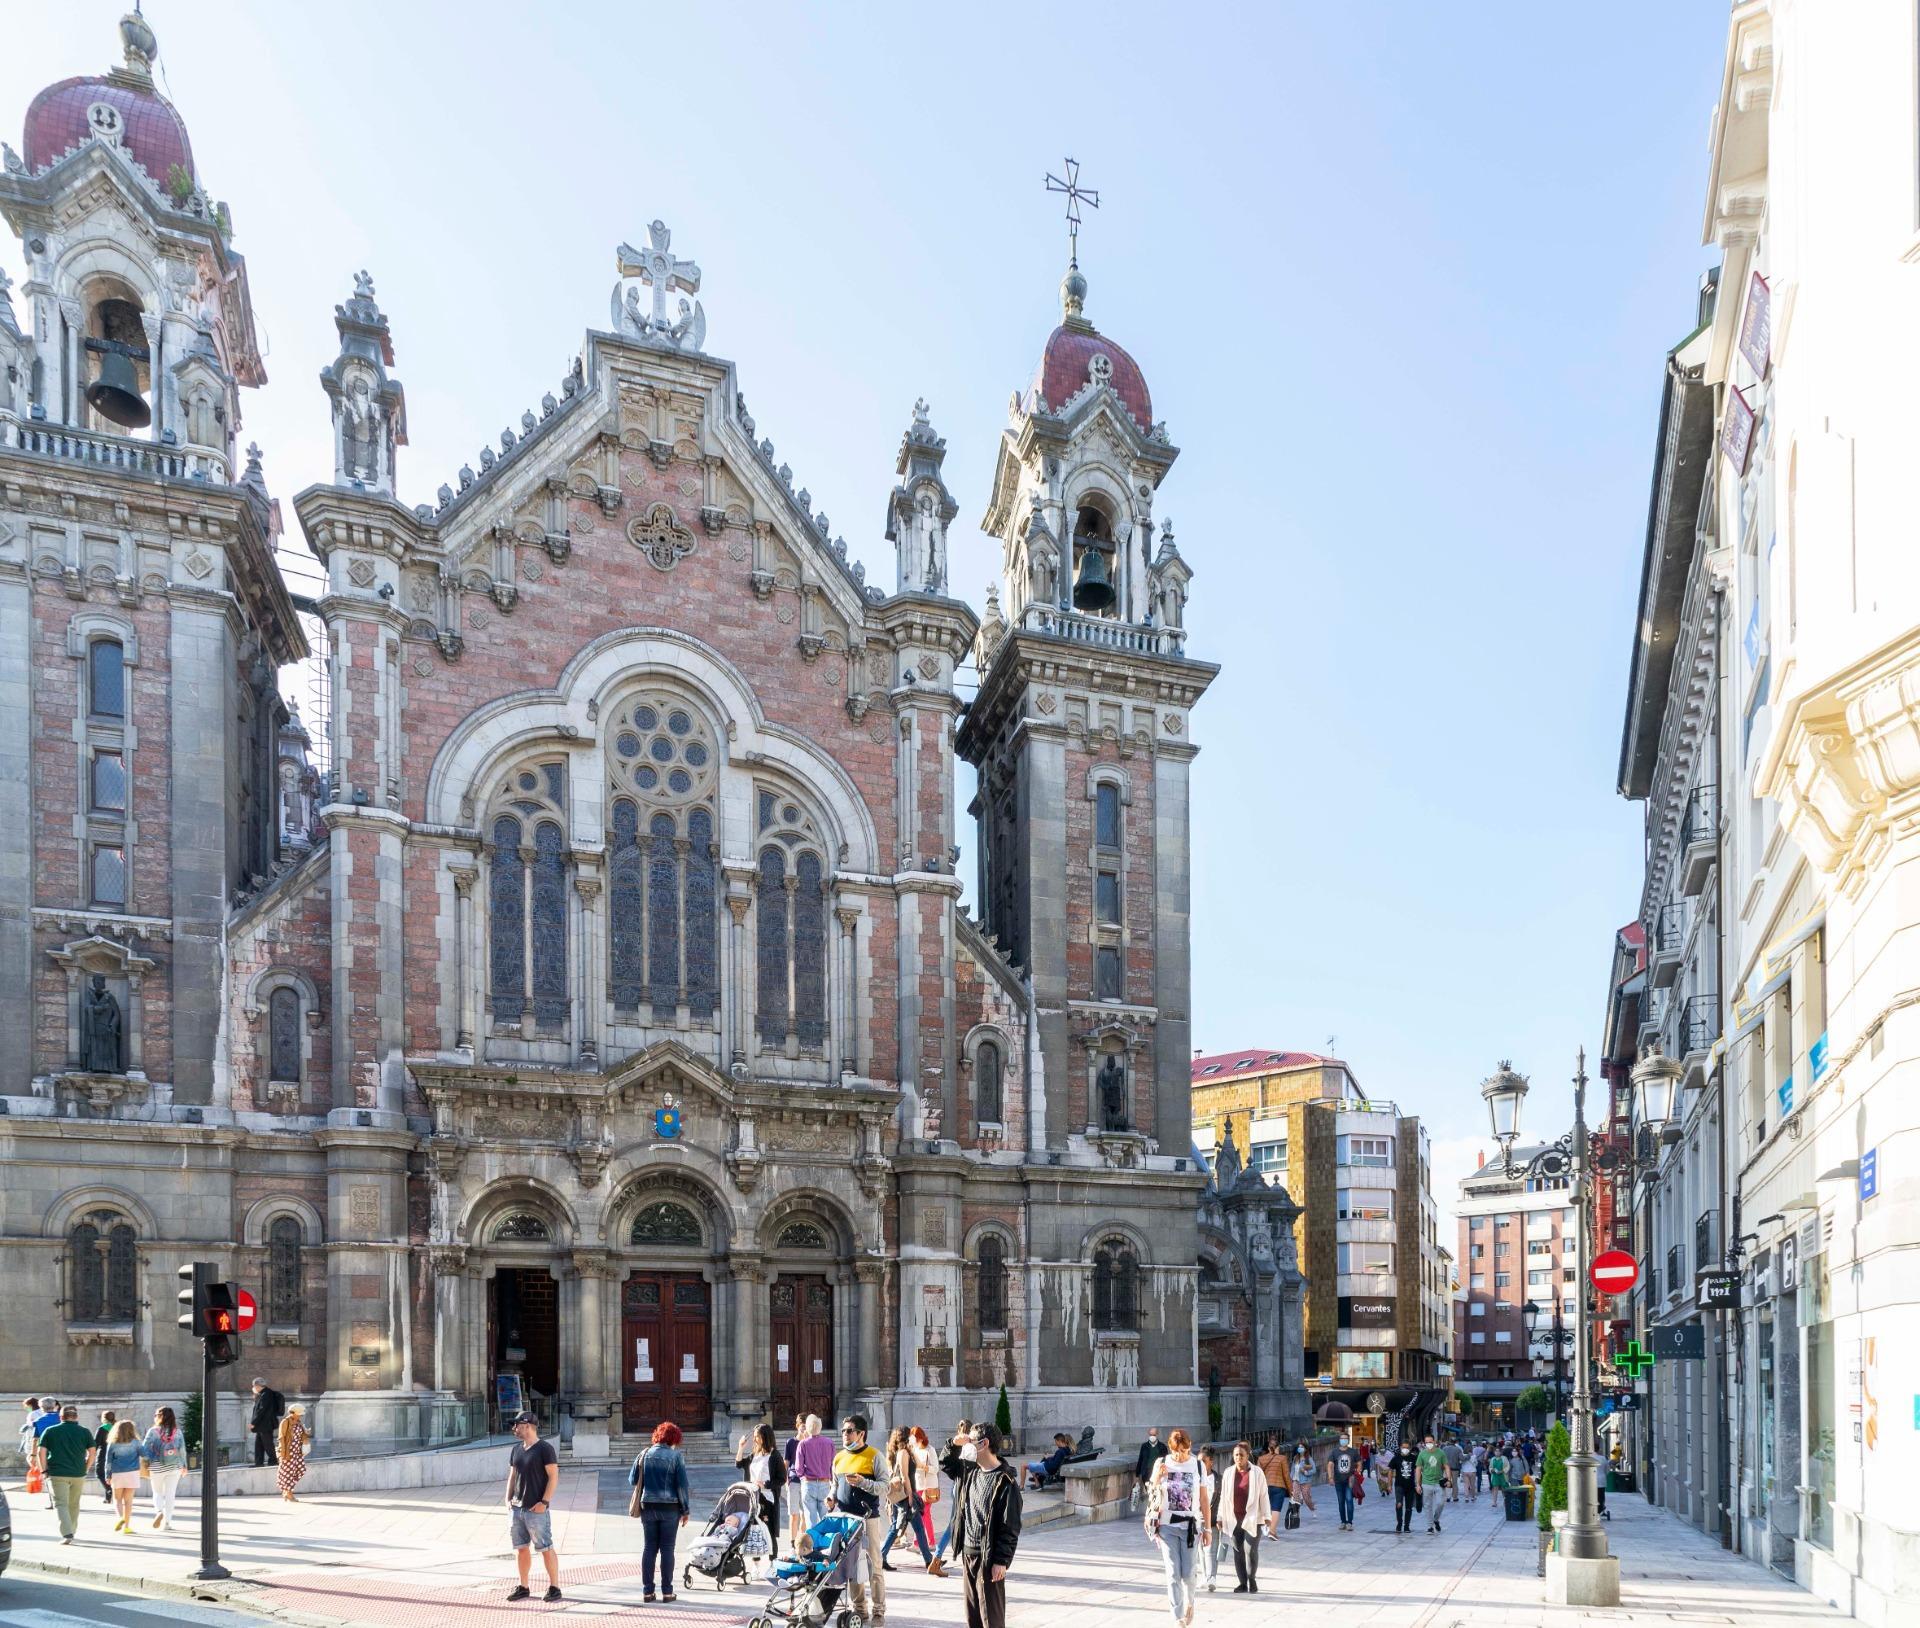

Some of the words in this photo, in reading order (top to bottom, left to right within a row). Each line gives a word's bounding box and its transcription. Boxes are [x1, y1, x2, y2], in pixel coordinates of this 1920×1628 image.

[613, 1186, 636, 1212] SAN
[636, 1175, 670, 1192] JUAN
[673, 1176, 690, 1189] EL
[1353, 1304, 1391, 1313] Cervantes
